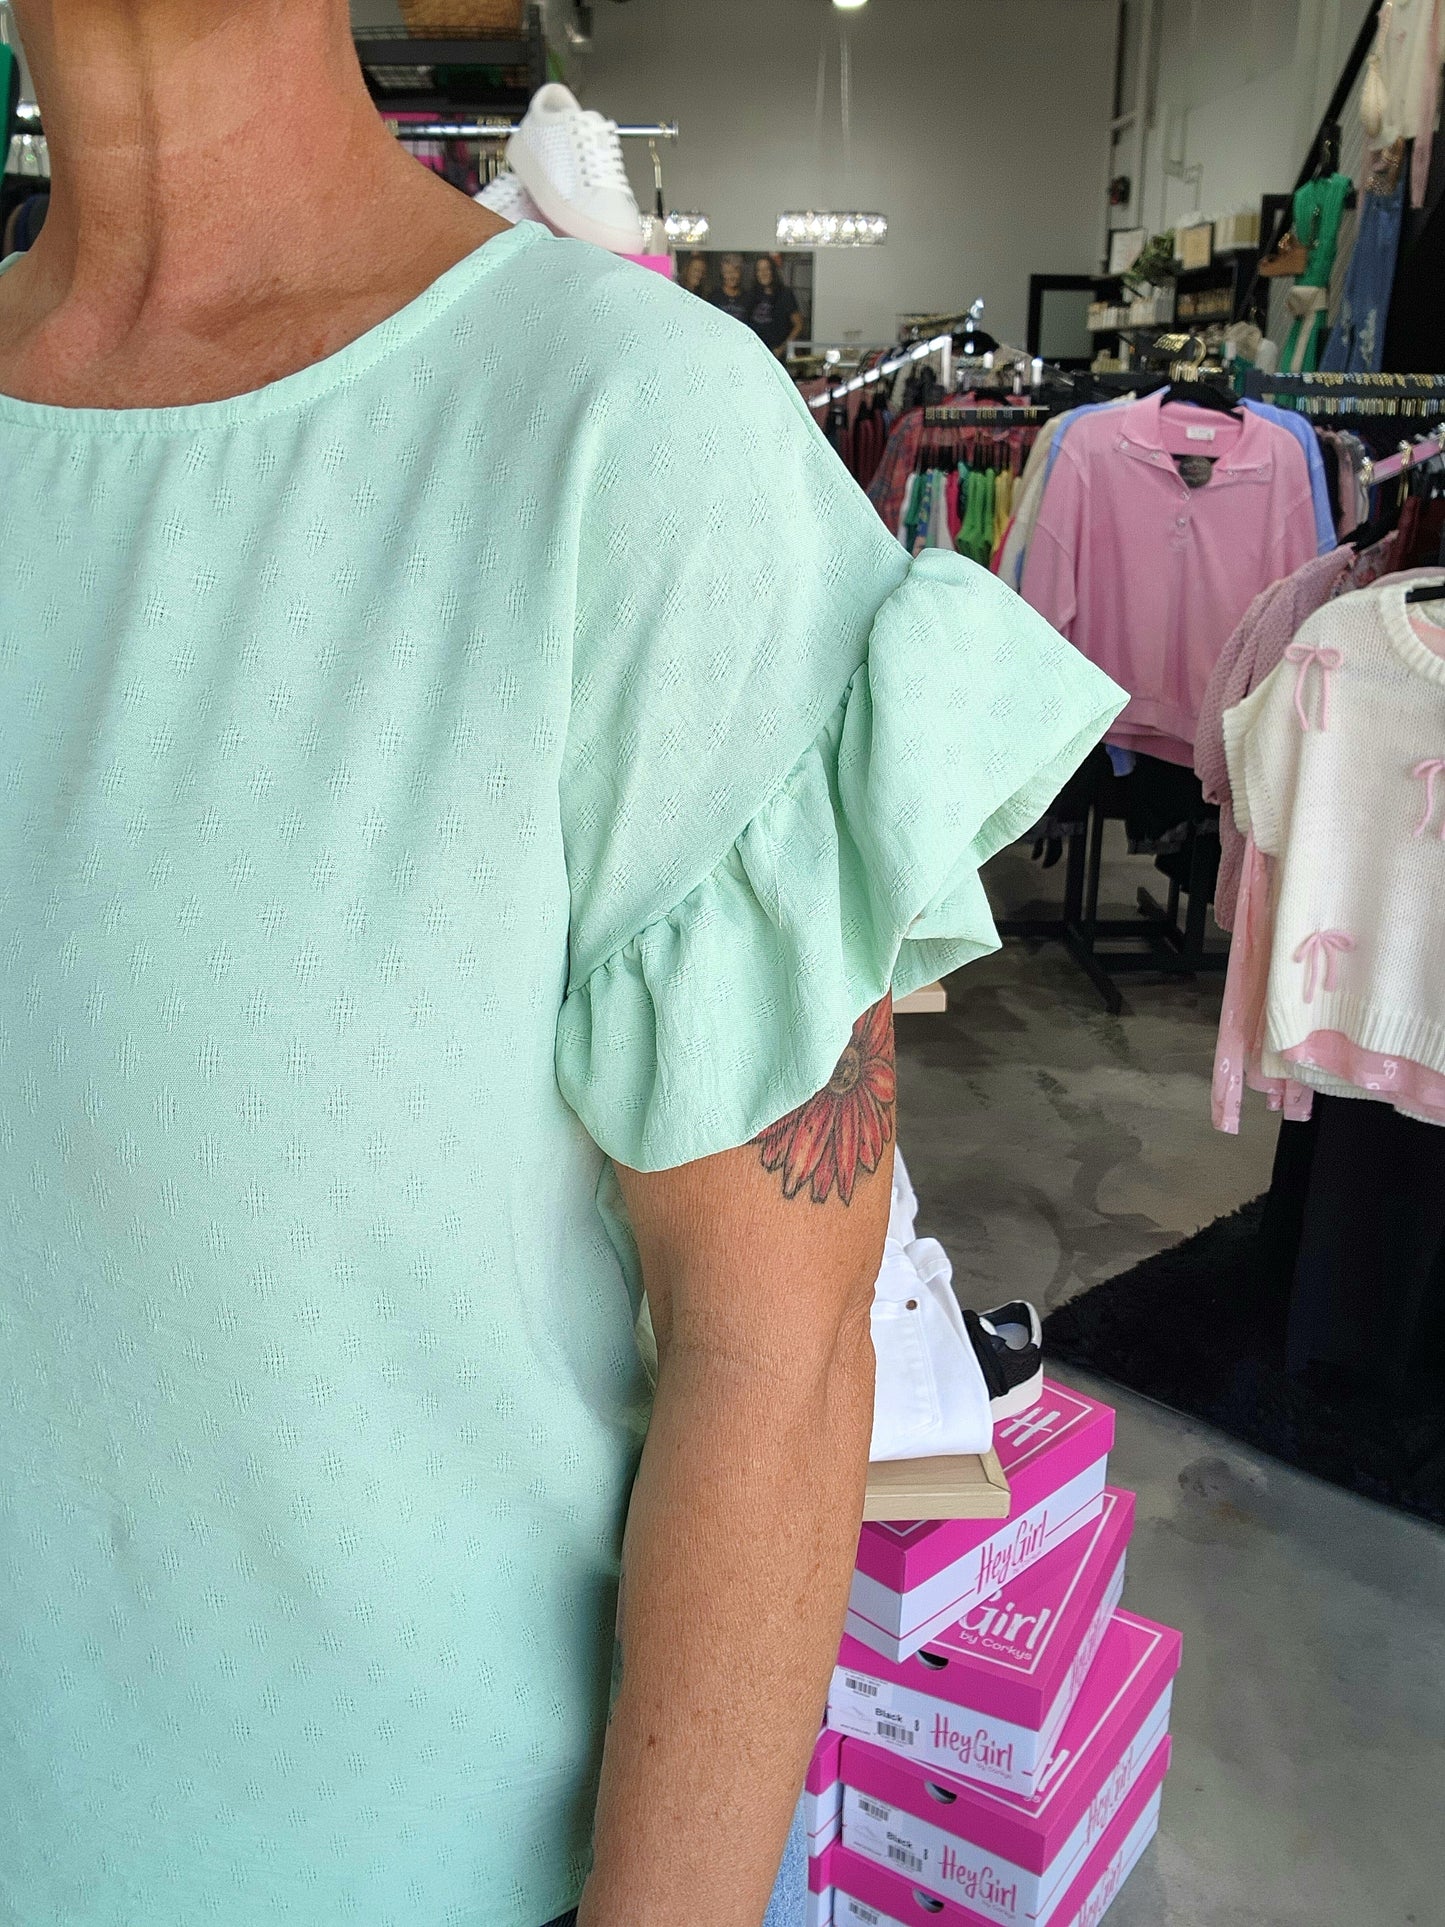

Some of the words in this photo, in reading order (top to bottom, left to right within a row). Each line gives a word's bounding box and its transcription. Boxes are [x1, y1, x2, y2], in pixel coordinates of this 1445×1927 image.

[959, 1630, 979, 1645] by
[981, 1638, 1033, 1661] Corkys
[875, 1707, 903, 1723] Black
[886, 1831, 913, 1848] Black
